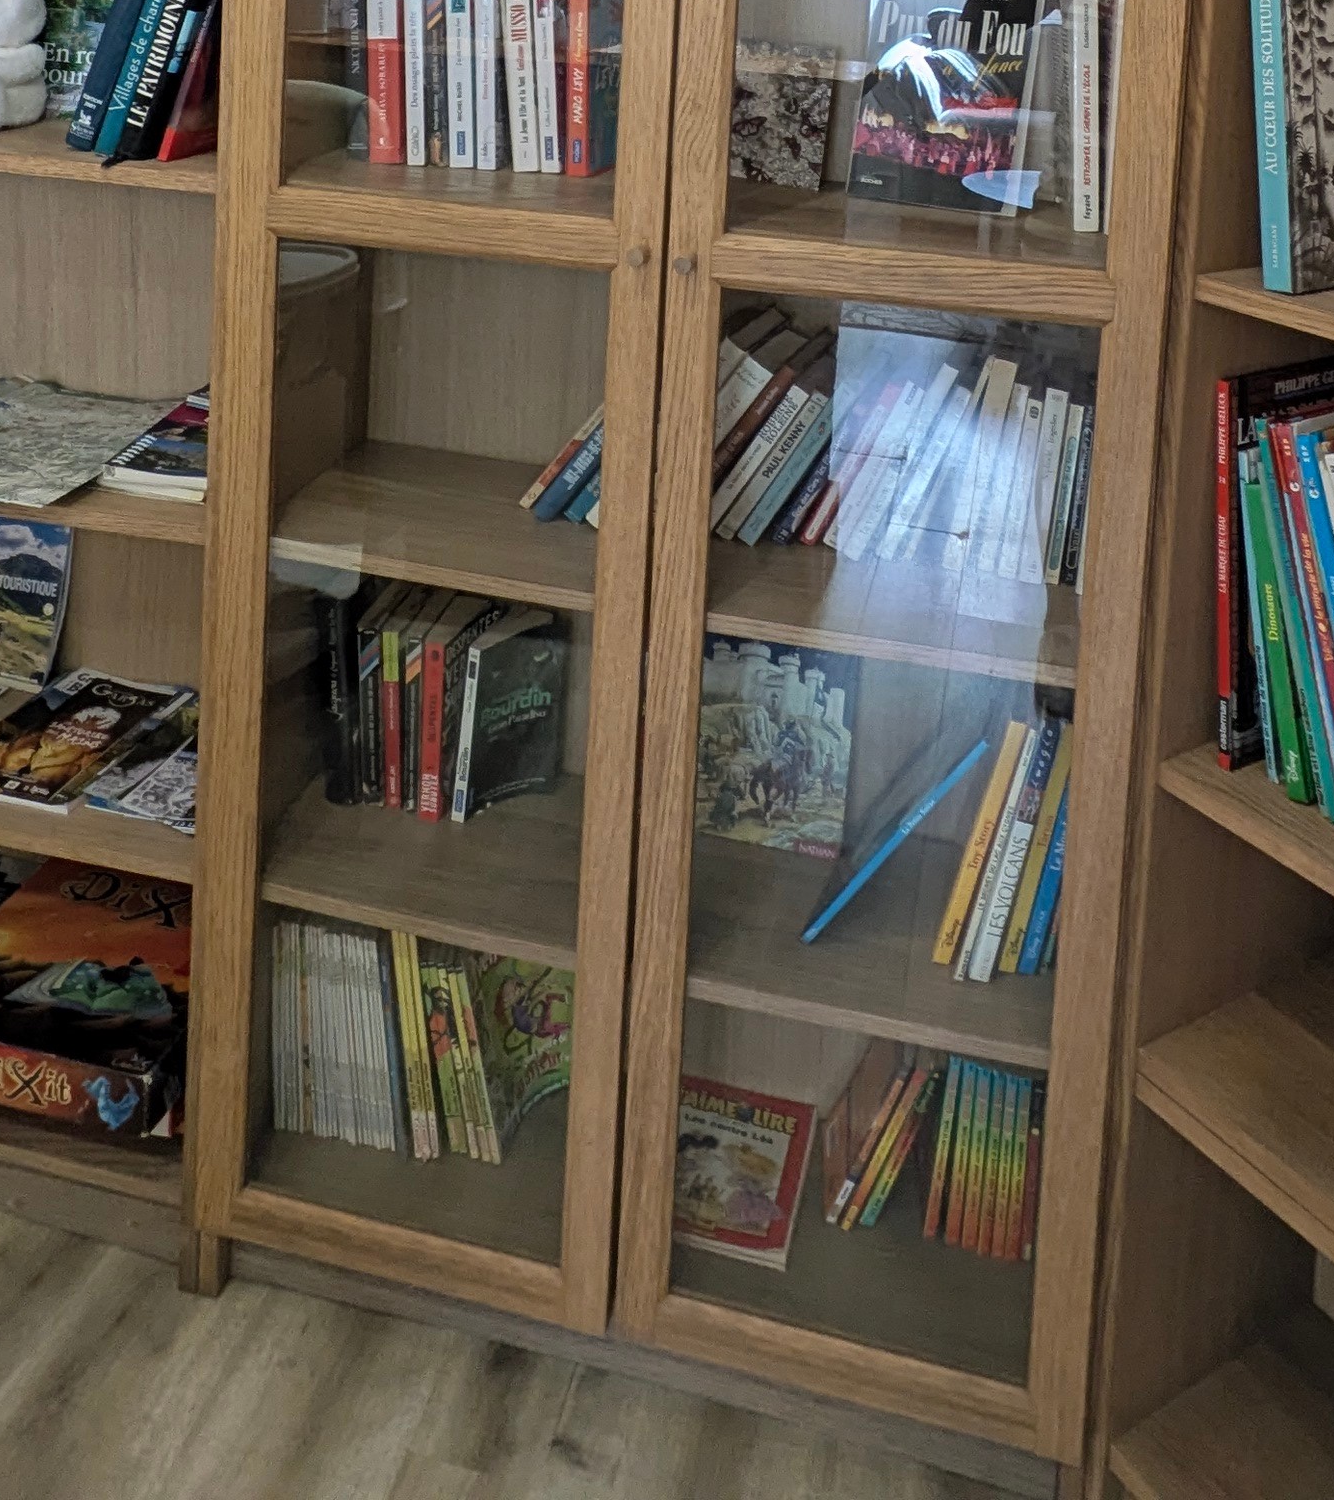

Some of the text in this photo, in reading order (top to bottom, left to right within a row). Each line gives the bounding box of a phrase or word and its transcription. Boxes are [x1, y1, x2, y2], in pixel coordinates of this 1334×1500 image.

[510, 4, 527, 41] MUSSO
[937, 15, 972, 49] du
[979, 10, 1027, 56] Fou
[108, 55, 141, 113] Villages
[130, 35, 148, 54] de
[572, 67, 584, 91] LEVY
[1260, 68, 1274, 96] DES
[129, 102, 149, 128] LE
[1261, 100, 1276, 147] CŒUR
[1263, 150, 1277, 175] AU
[1275, 372, 1321, 395] PHILIPPE
[1238, 415, 1258, 445] LA
[760, 419, 807, 479] PAUL KENNY
[1263, 583, 1278, 641] Dinosaure
[1218, 700, 1227, 749] casterman
[991, 835, 1032, 910] VOLCANS
[985, 911, 1007, 939] LES
